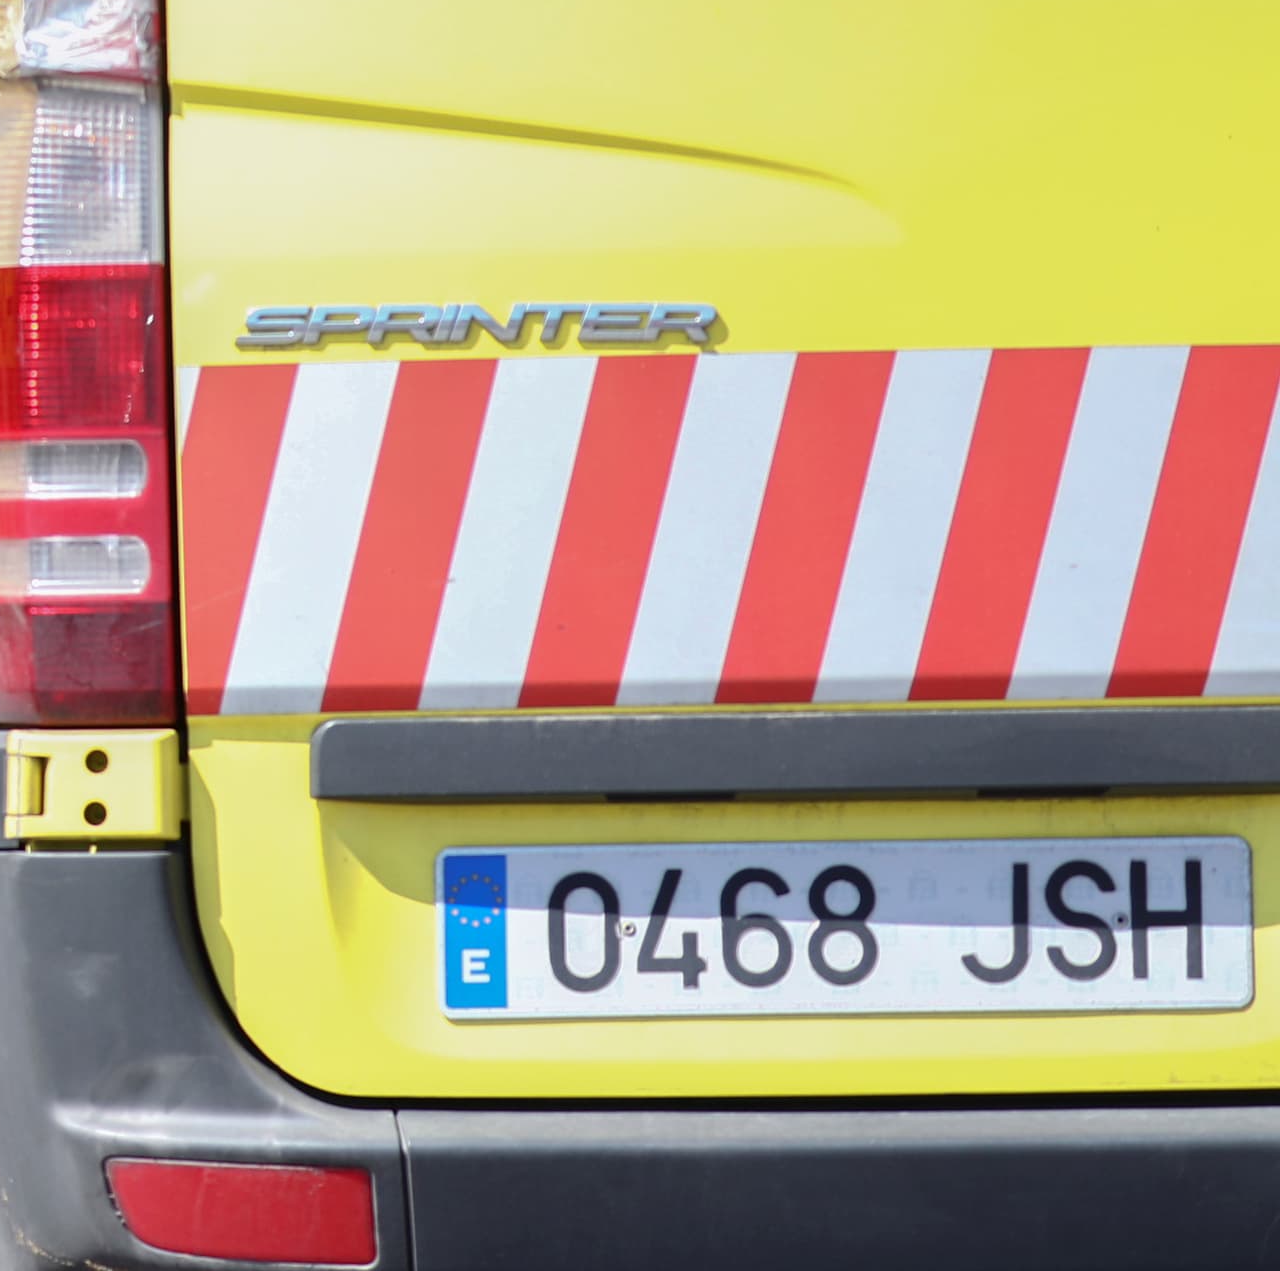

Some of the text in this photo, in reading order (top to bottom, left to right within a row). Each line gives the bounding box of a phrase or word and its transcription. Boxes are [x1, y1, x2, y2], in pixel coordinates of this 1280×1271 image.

[235, 302, 720, 350] SPRINTER
[545, 858, 1204, 994] 0468 JSH
[460, 948, 491, 984] E
